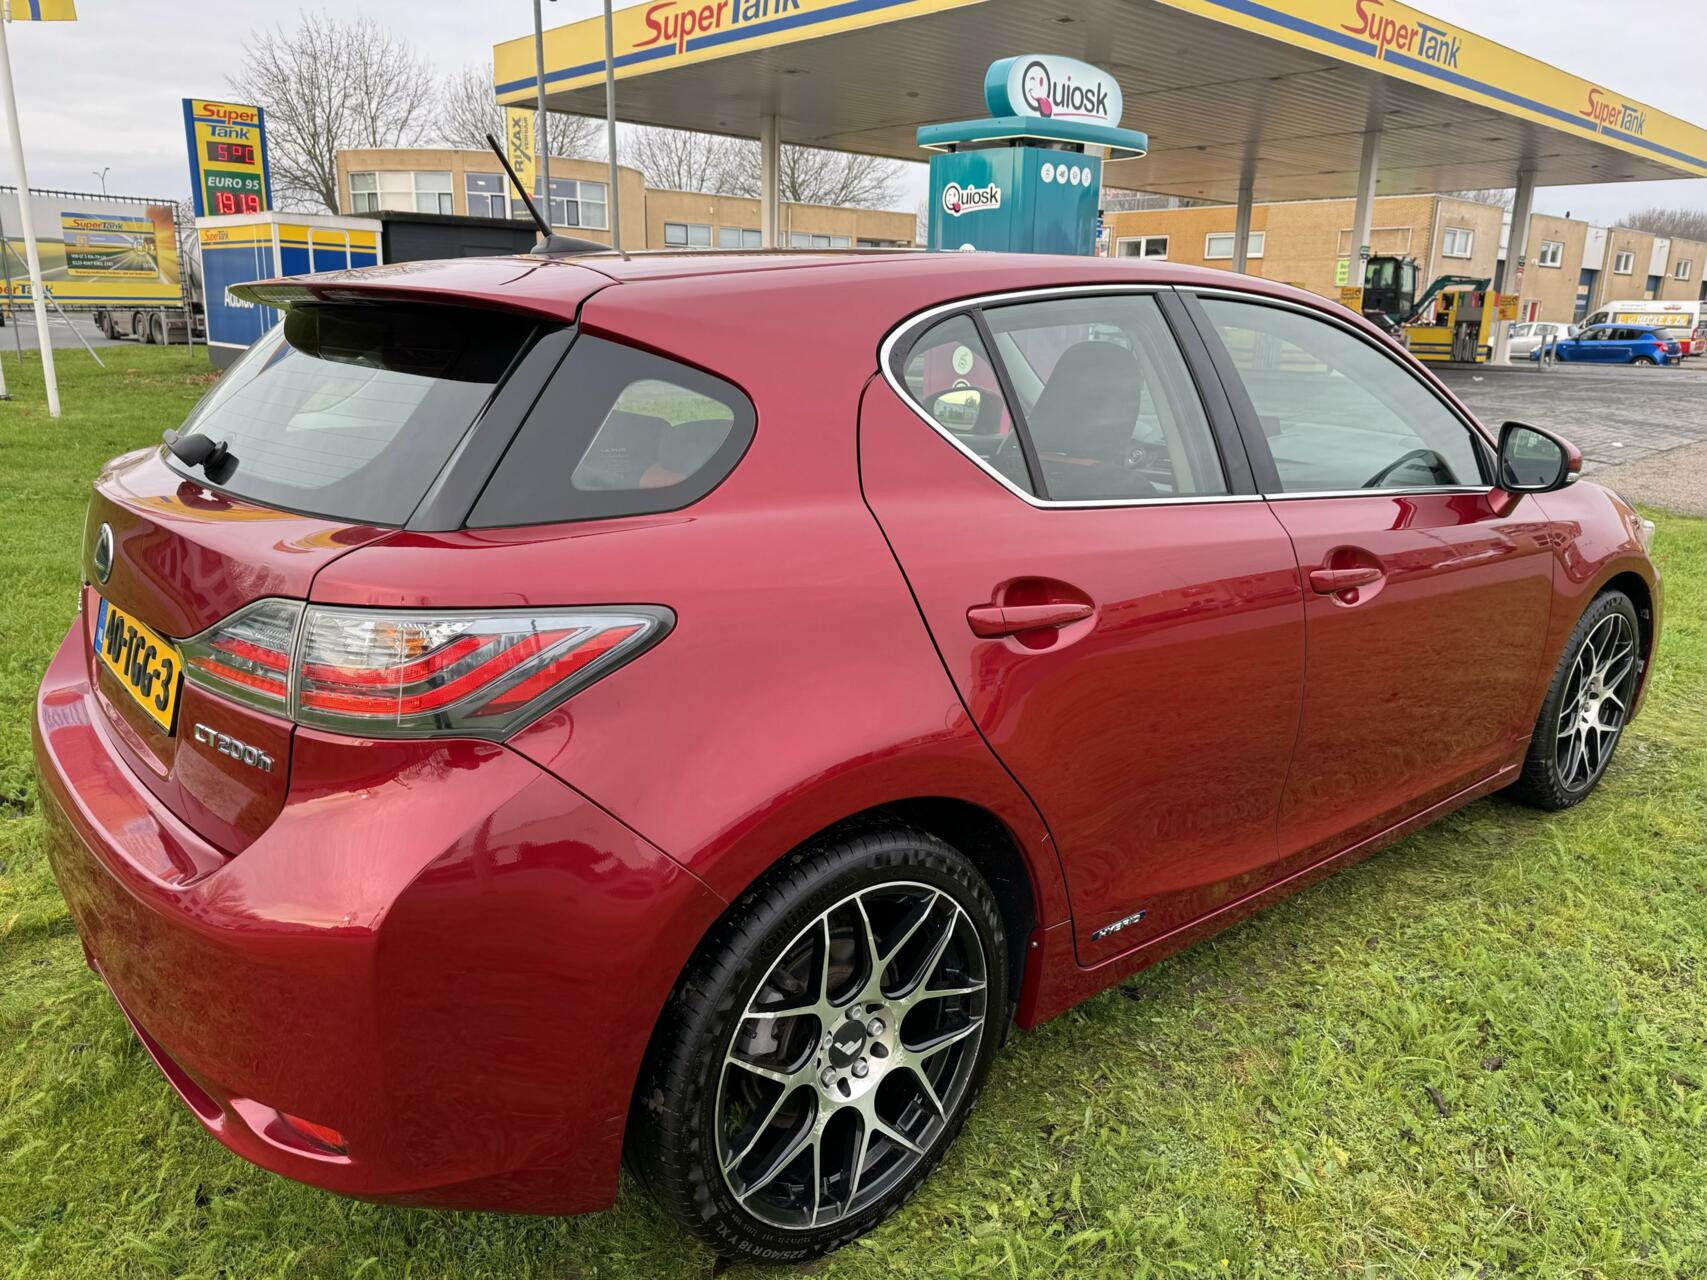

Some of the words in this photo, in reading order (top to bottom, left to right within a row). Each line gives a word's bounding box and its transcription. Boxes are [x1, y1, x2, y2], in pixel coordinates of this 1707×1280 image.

[632, 0, 800, 54] SuperTank
[1340, 0, 1461, 69] SuperTank
[1022, 61, 1108, 118] Quiosk
[1579, 88, 1646, 136] SuperTank
[194, 103, 257, 125] Super
[206, 124, 249, 140] Tank
[207, 176, 243, 188] EURO
[246, 179, 260, 190] 95
[944, 185, 999, 213] Quiosk
[106, 609, 174, 713] 40-TGG-3
